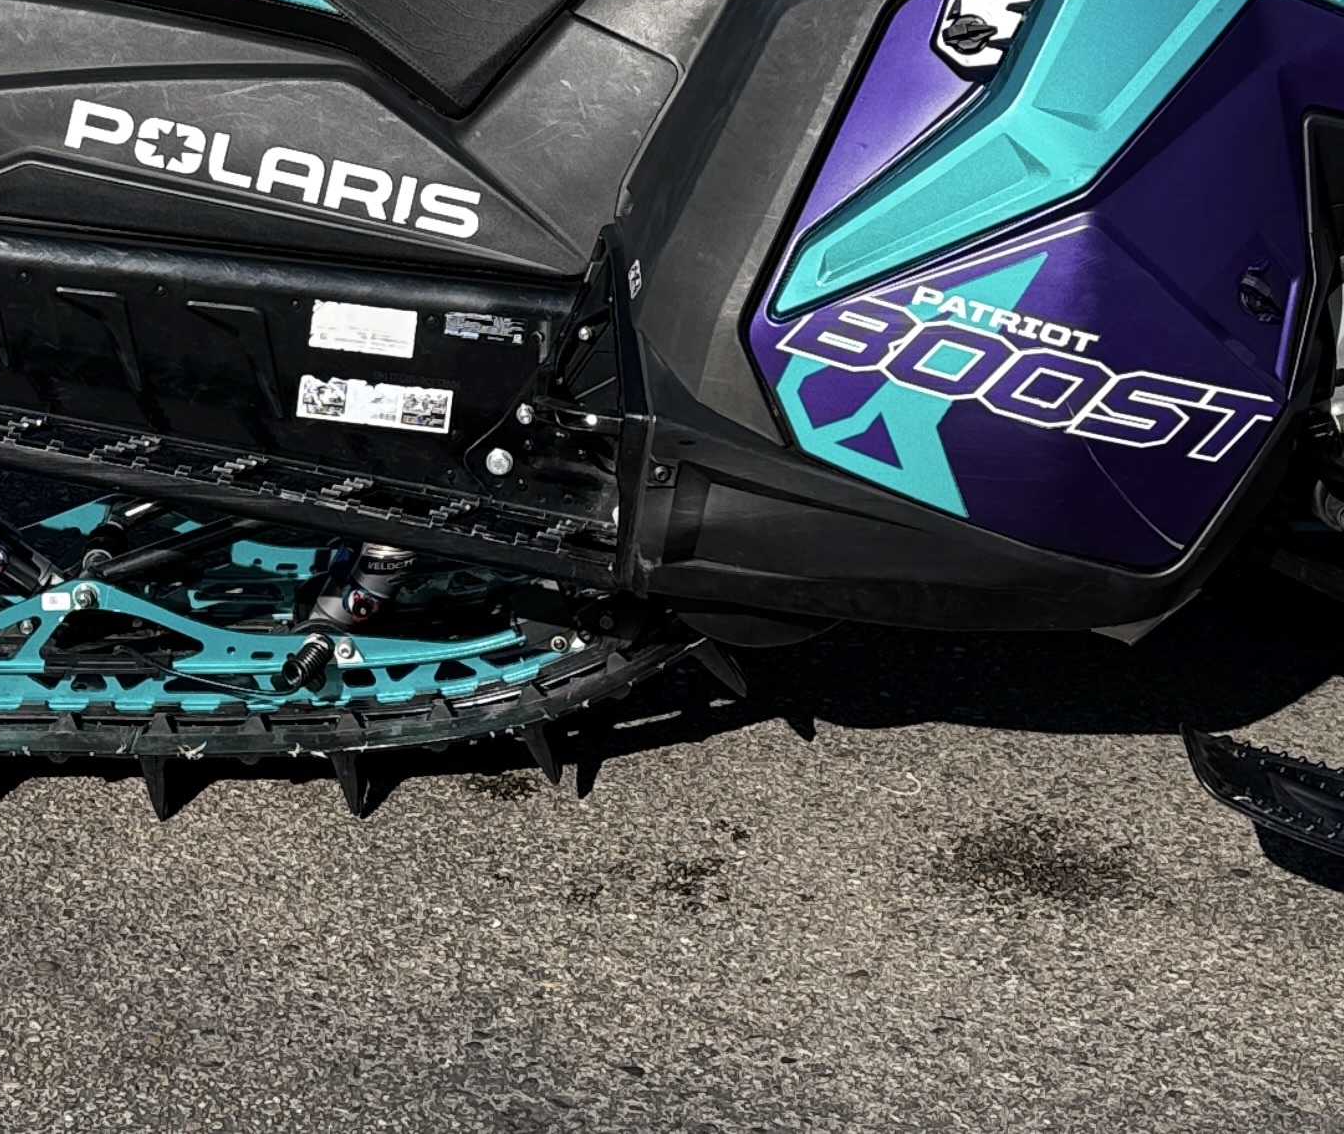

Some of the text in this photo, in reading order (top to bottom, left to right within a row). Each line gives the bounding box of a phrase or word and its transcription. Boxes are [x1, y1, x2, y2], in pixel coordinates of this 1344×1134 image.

[64, 99, 482, 239] POLARIS
[776, 296, 1276, 462] BOOST
[912, 286, 1100, 353] PATRIOT
